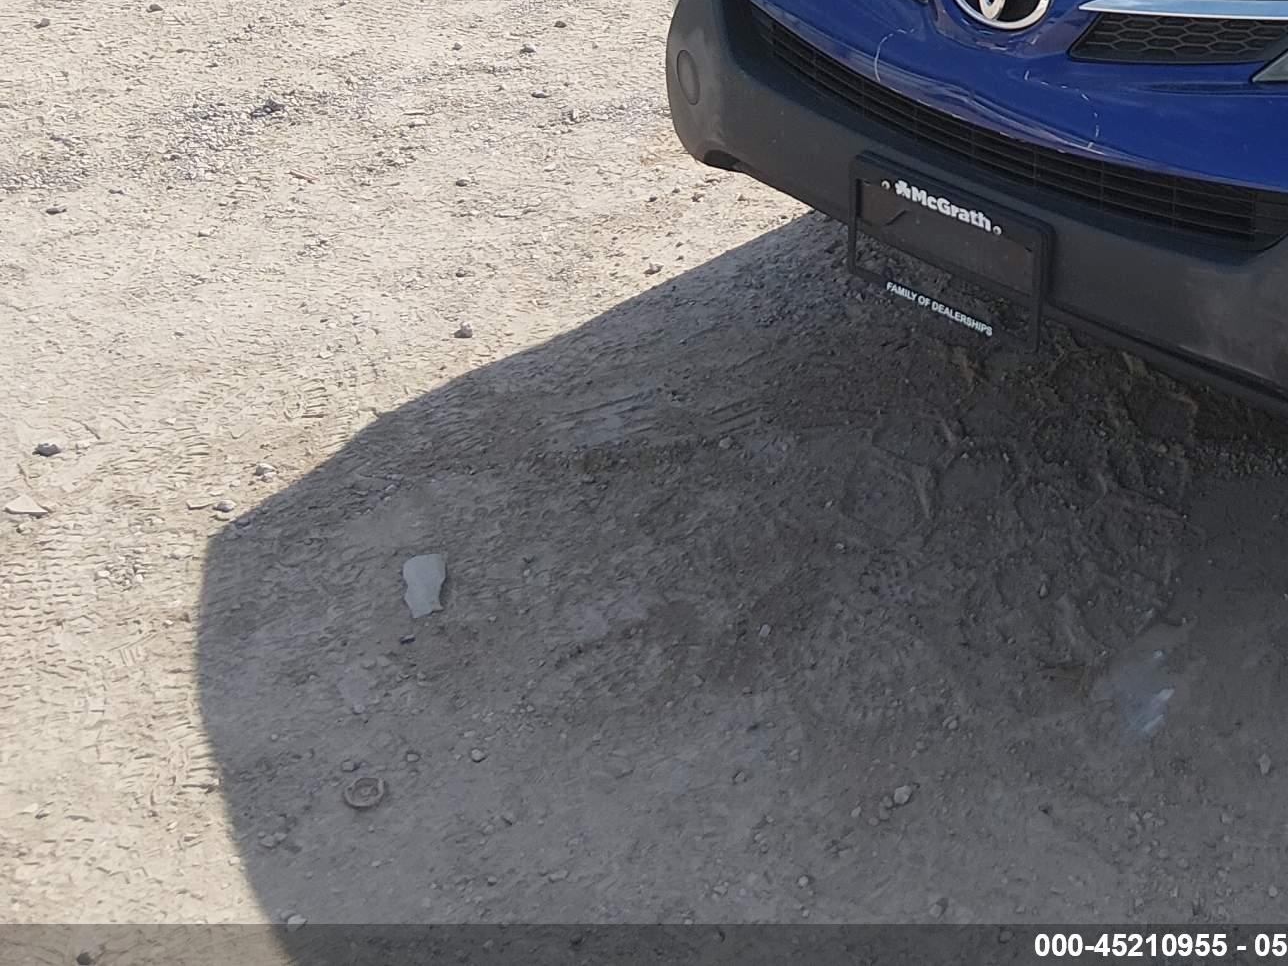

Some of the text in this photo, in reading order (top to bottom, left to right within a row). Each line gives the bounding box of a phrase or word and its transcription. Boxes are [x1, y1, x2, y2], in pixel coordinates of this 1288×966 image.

[911, 186, 992, 232] McGrath
[886, 281, 993, 336] FAMILY OF DEALERSHIPS
